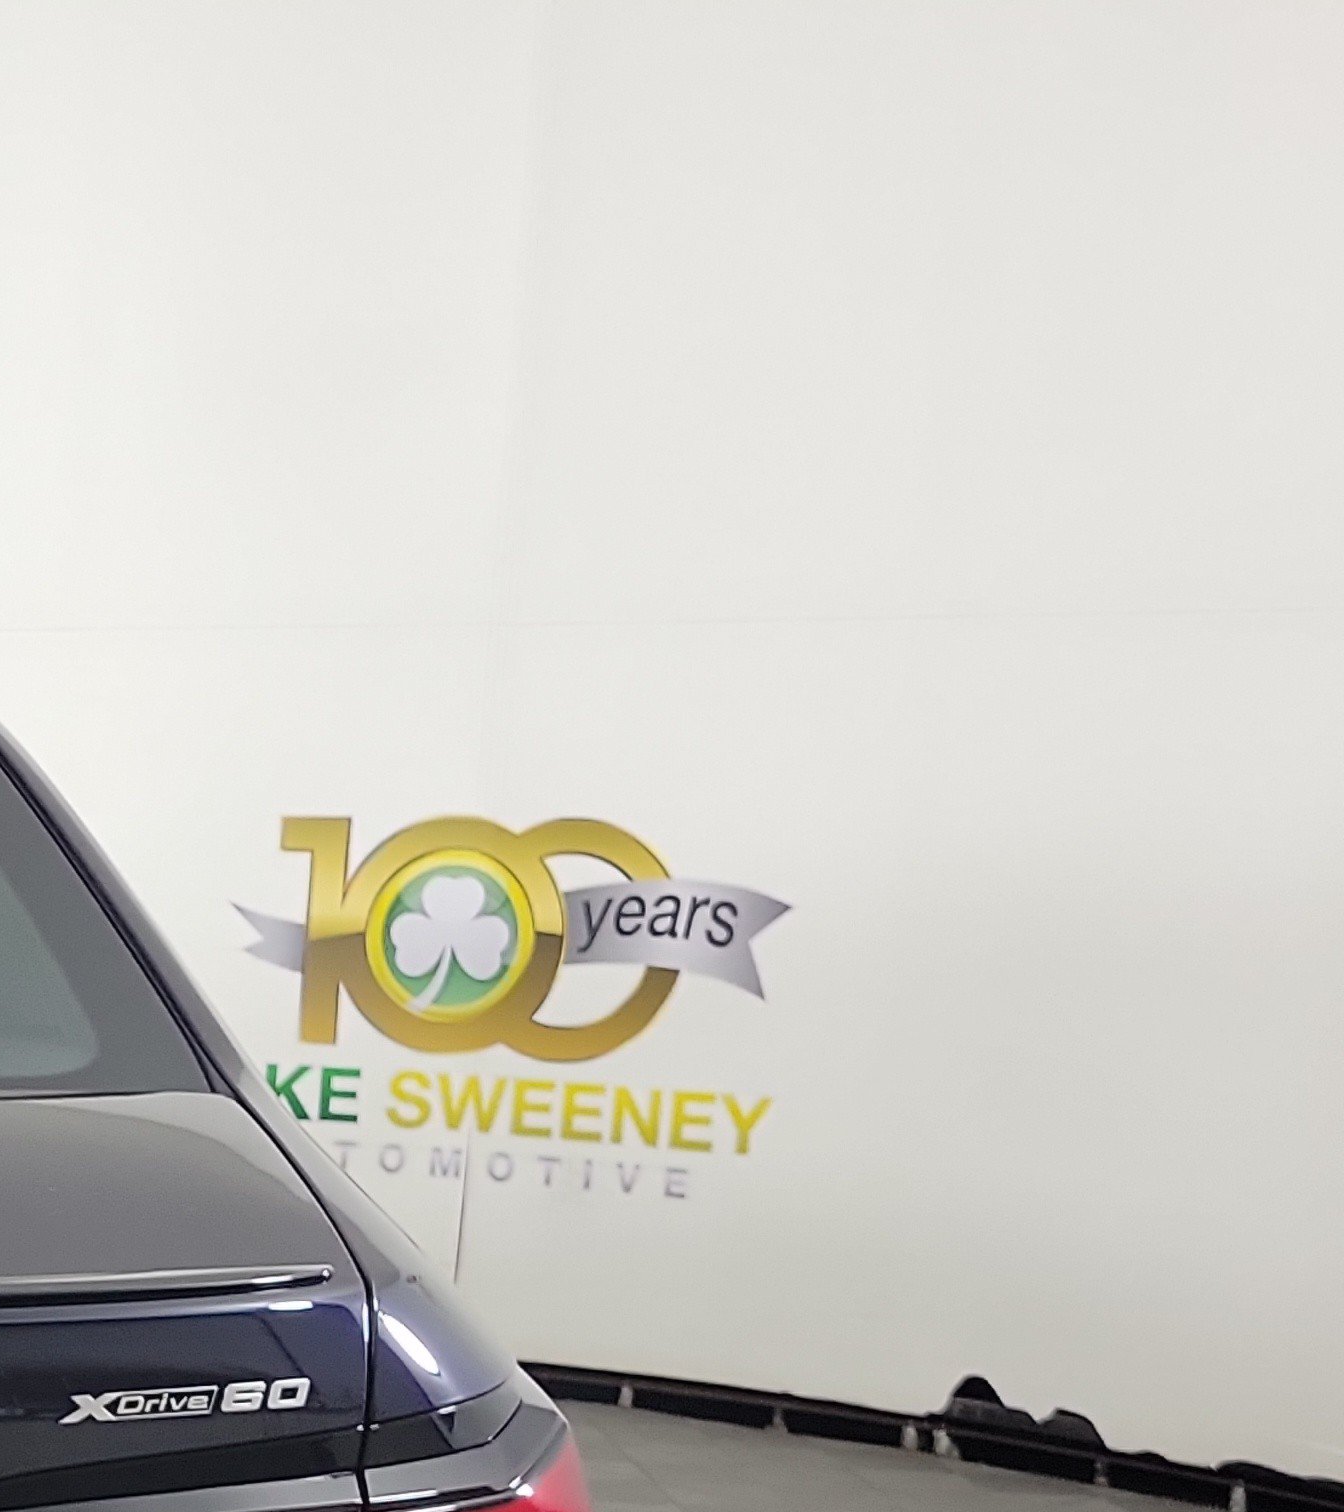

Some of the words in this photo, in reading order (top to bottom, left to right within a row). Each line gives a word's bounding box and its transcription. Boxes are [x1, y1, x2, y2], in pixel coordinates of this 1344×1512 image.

[280, 815, 680, 1063] 100
[576, 893, 740, 954] years
[266, 1063, 361, 1123] KE
[386, 1068, 773, 1155] SWEENEY
[333, 1139, 691, 1200] TOMOTIVE
[220, 1377, 311, 1413] 60
